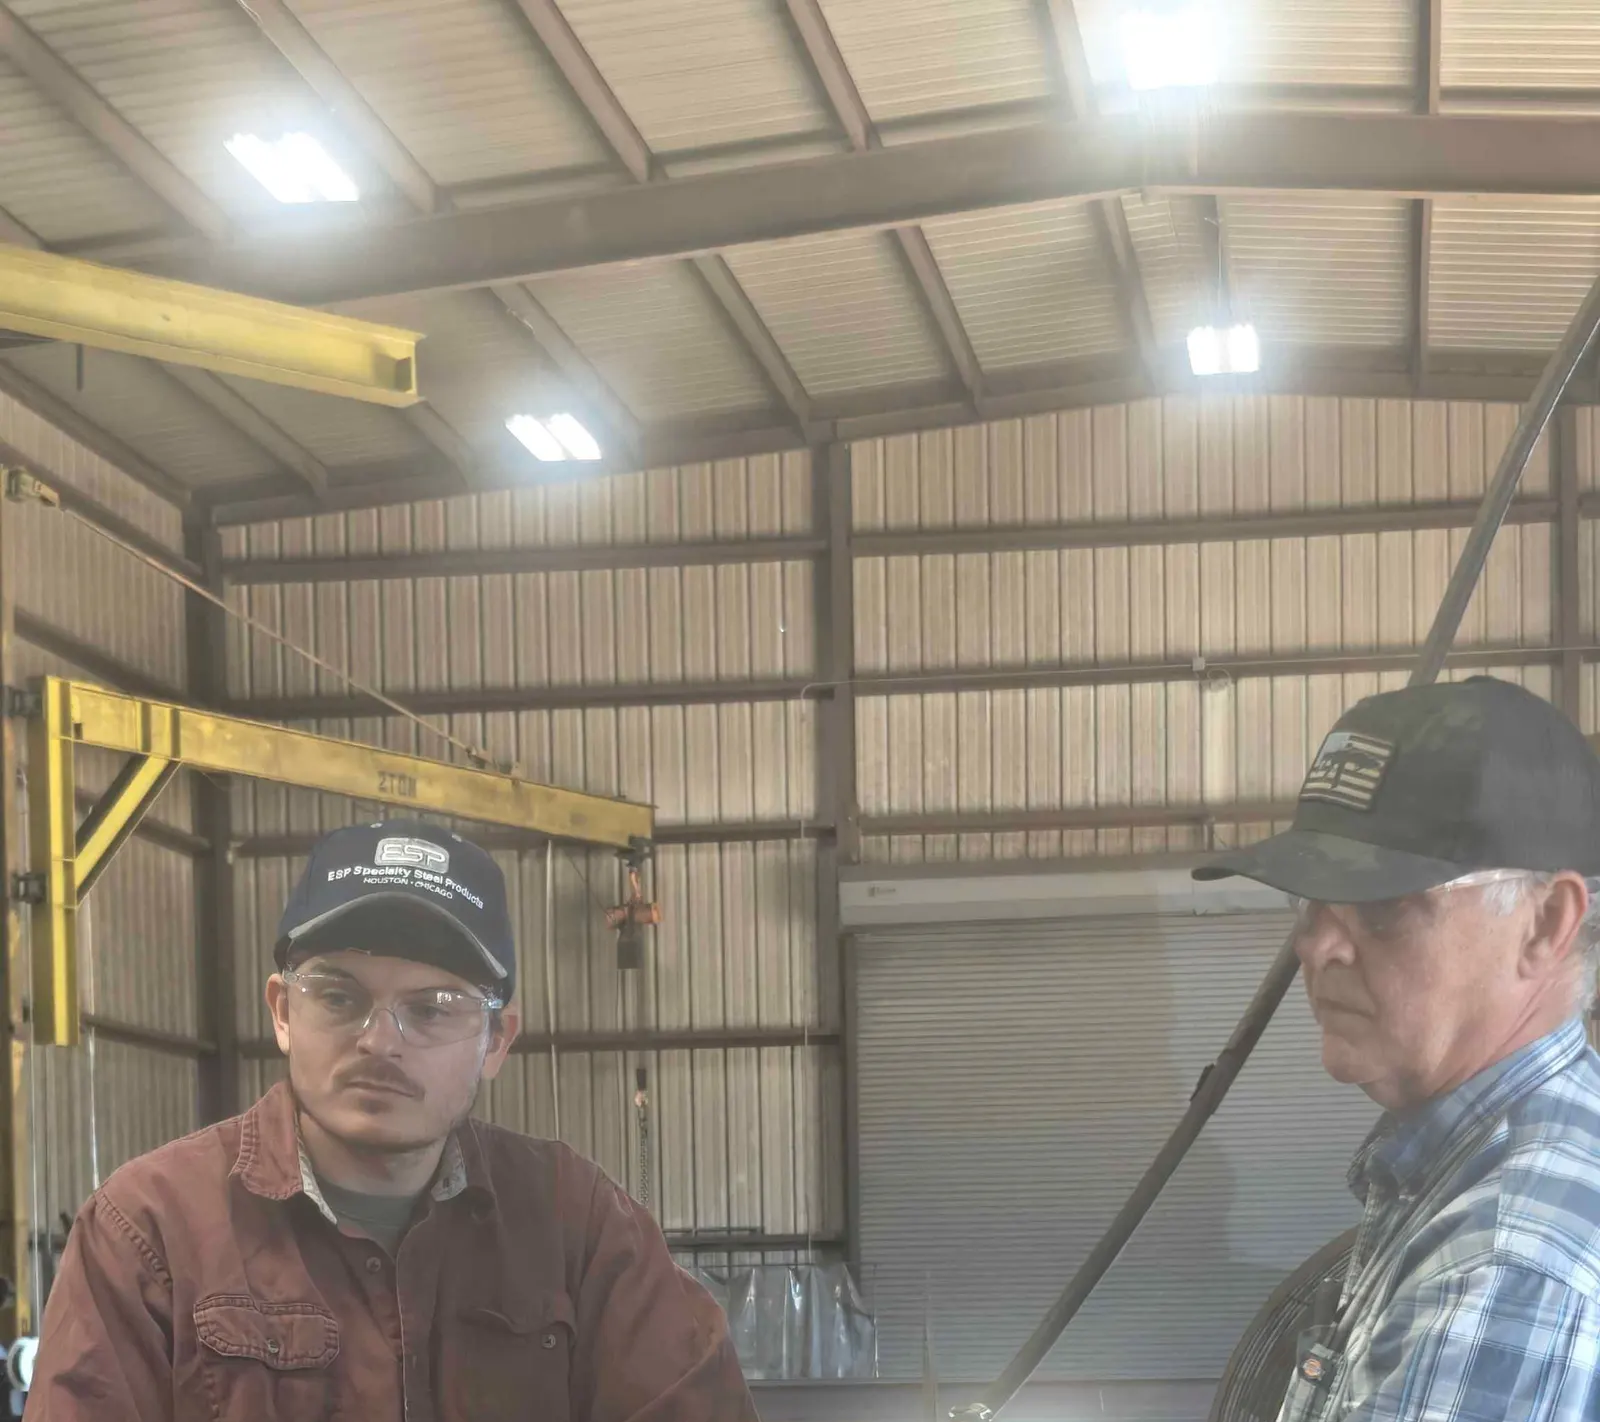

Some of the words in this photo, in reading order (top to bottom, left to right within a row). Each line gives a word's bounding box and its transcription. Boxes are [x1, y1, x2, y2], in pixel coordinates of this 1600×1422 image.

[381, 843, 446, 866] ESP
[327, 867, 351, 882] ESP
[353, 865, 411, 877] Specialty
[413, 869, 443, 885] Steel
[445, 877, 484, 909] Products
[363, 876, 408, 885] HOUSTON
[414, 880, 453, 899] CHICAGO
